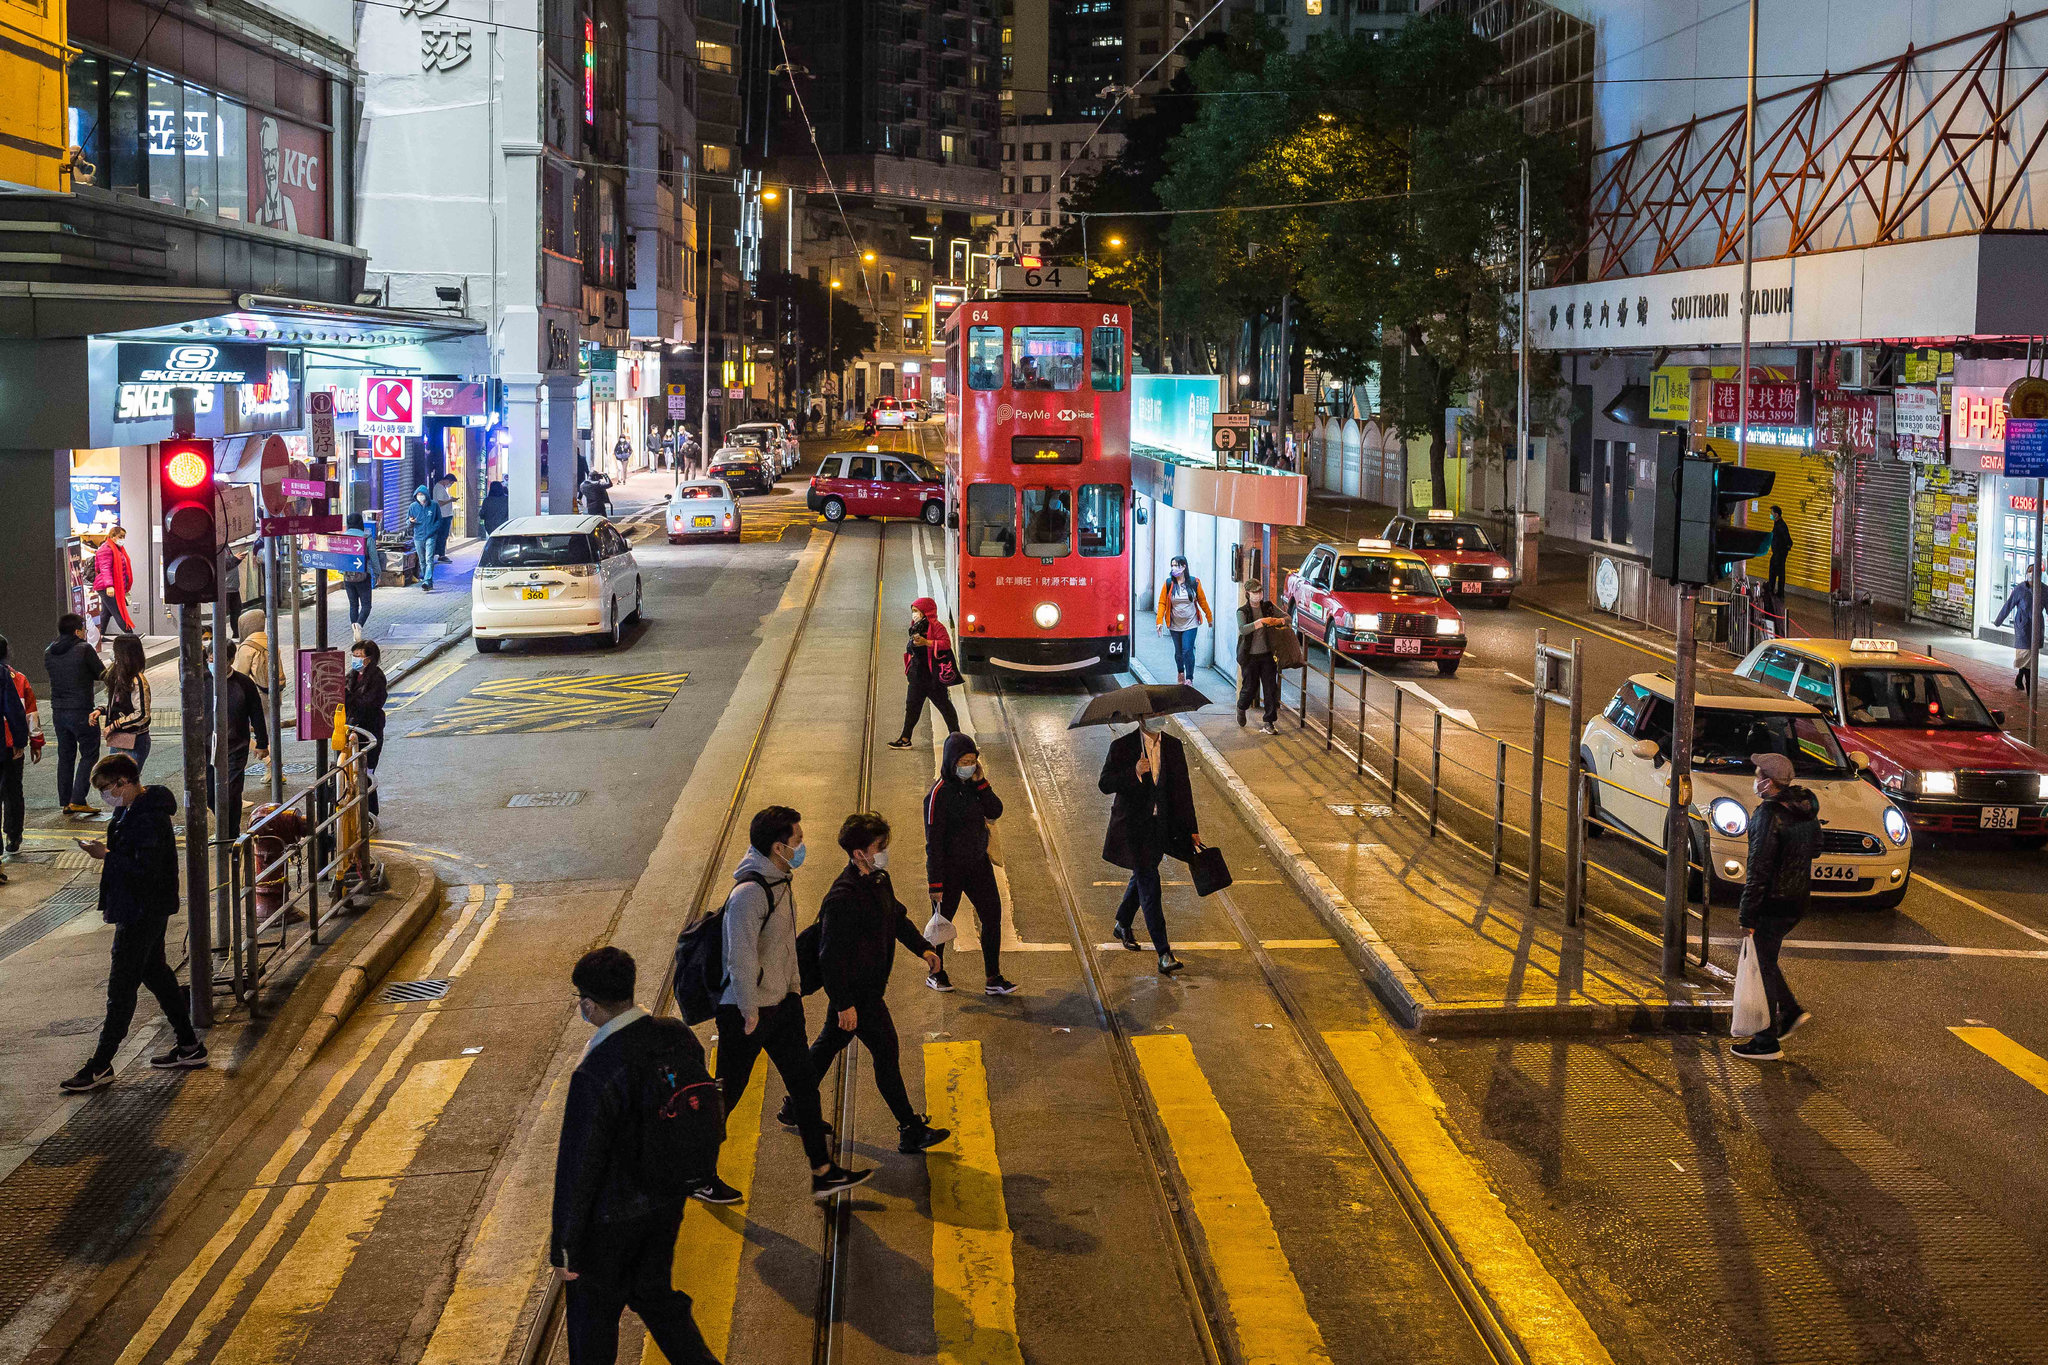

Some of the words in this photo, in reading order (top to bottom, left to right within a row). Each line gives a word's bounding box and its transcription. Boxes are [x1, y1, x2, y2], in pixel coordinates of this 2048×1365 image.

[282, 148, 318, 192] KFC
[1025, 268, 1062, 288] 64
[1671, 292, 1729, 321] SOUTHORN
[972, 310, 989, 322] 64
[1102, 313, 1119, 325] 64
[139, 370, 246, 383] SKECHERS
[422, 386, 454, 398] Sasa
[1015, 409, 1051, 422] PayMe
[1767, 410, 1794, 420] 3899
[363, 424, 416, 434] 24小時營業
[527, 592, 544, 600] 360
[1109, 642, 1123, 654] 64
[1396, 646, 1419, 654] 3329
[1859, 640, 1895, 650] TAXI
[1992, 808, 2007, 818] SX
[1983, 817, 2014, 829] 7984
[1813, 865, 1854, 879] 6346
